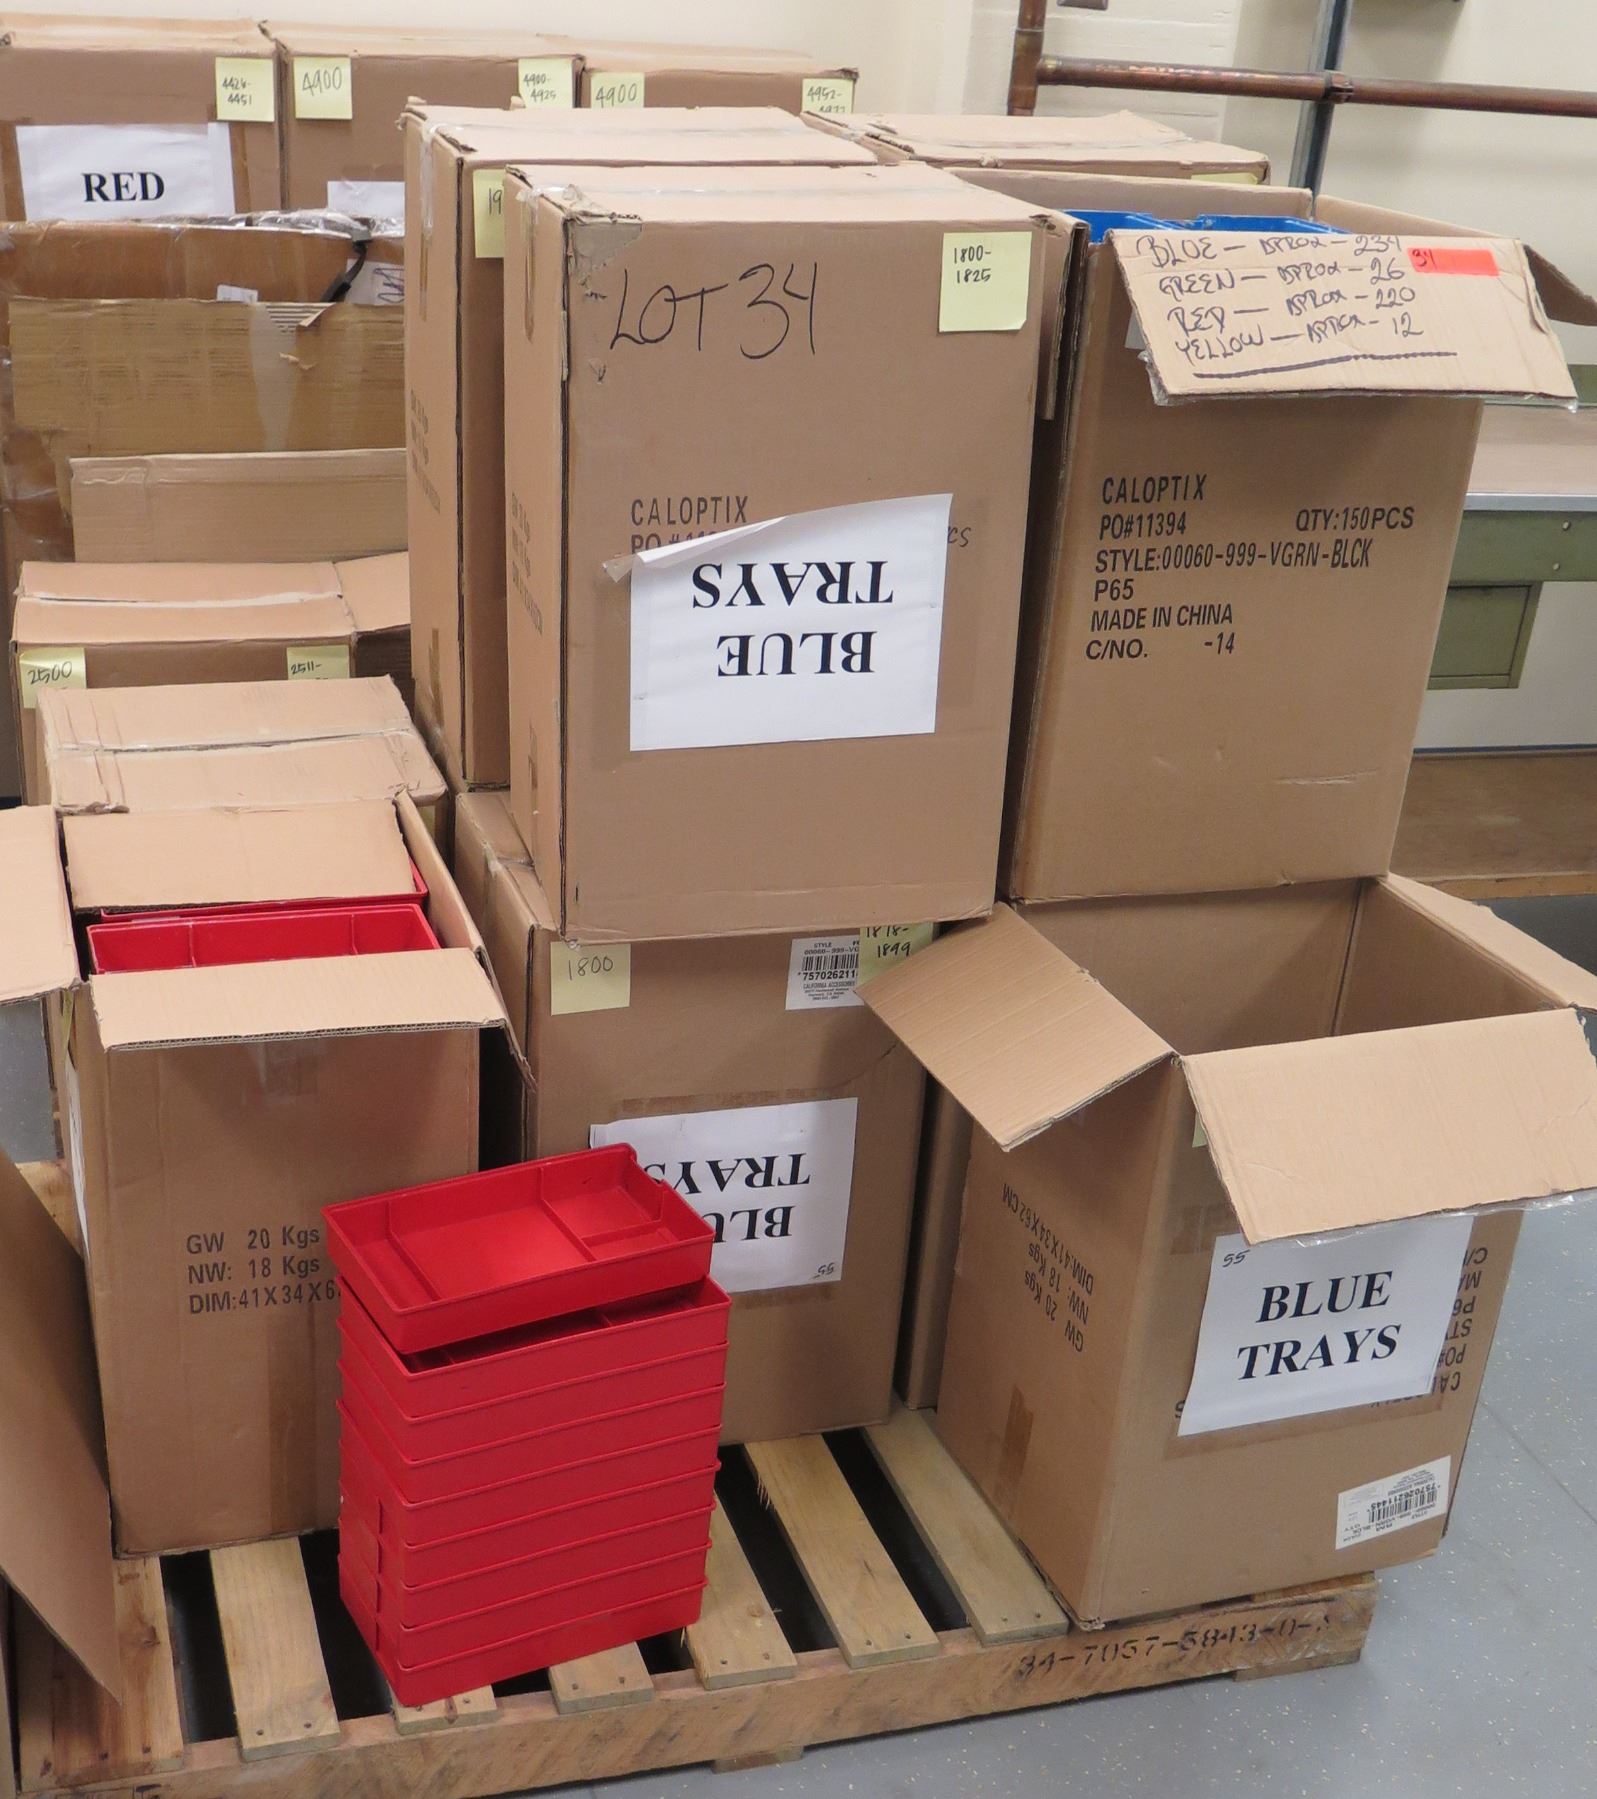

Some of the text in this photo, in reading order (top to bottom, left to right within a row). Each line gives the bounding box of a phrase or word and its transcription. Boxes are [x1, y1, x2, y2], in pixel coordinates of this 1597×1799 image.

[302, 67, 342, 96] 4900
[595, 83, 638, 108] 4900
[81, 171, 166, 203] RED
[488, 187, 503, 215] 19
[953, 244, 992, 265] 1800-
[1135, 234, 1218, 268] BLUE
[1353, 234, 1403, 257] 234
[956, 268, 992, 284] 1825
[1158, 268, 1236, 302] GREEN
[1369, 256, 1406, 286] 26
[609, 261, 818, 360] LOT 34
[1166, 305, 1226, 338] RED
[1375, 285, 1417, 311] 220
[1174, 323, 1265, 368] YELLOW
[1391, 311, 1425, 338] 12
[1102, 473, 1207, 505] CALOPTIX
[630, 495, 749, 526] CALOPTIX
[1099, 511, 1188, 541] PO#11394
[947, 526, 972, 547] CS
[691, 559, 895, 609] TRAYS
[1094, 577, 1135, 602] P65
[1090, 602, 1234, 633] MADE IN CHINA
[716, 630, 878, 678] BLUE
[1085, 638, 1149, 661] C/NO.
[27, 660, 74, 686] 2500
[877, 941, 912, 959] 1899
[567, 954, 614, 981] 1800
[186, 1224, 321, 1255] GW 20 Kgs
[701, 1204, 797, 1244] BLU
[188, 1254, 321, 1285] NW: 18 Kgs
[1028, 1242, 1047, 1277] Kgs
[1048, 1266, 1061, 1293] 18
[1024, 1269, 1084, 1353] GW 20 Kgs
[1255, 1269, 1393, 1324] BLUE
[1236, 1323, 1402, 1381] TRAYS
